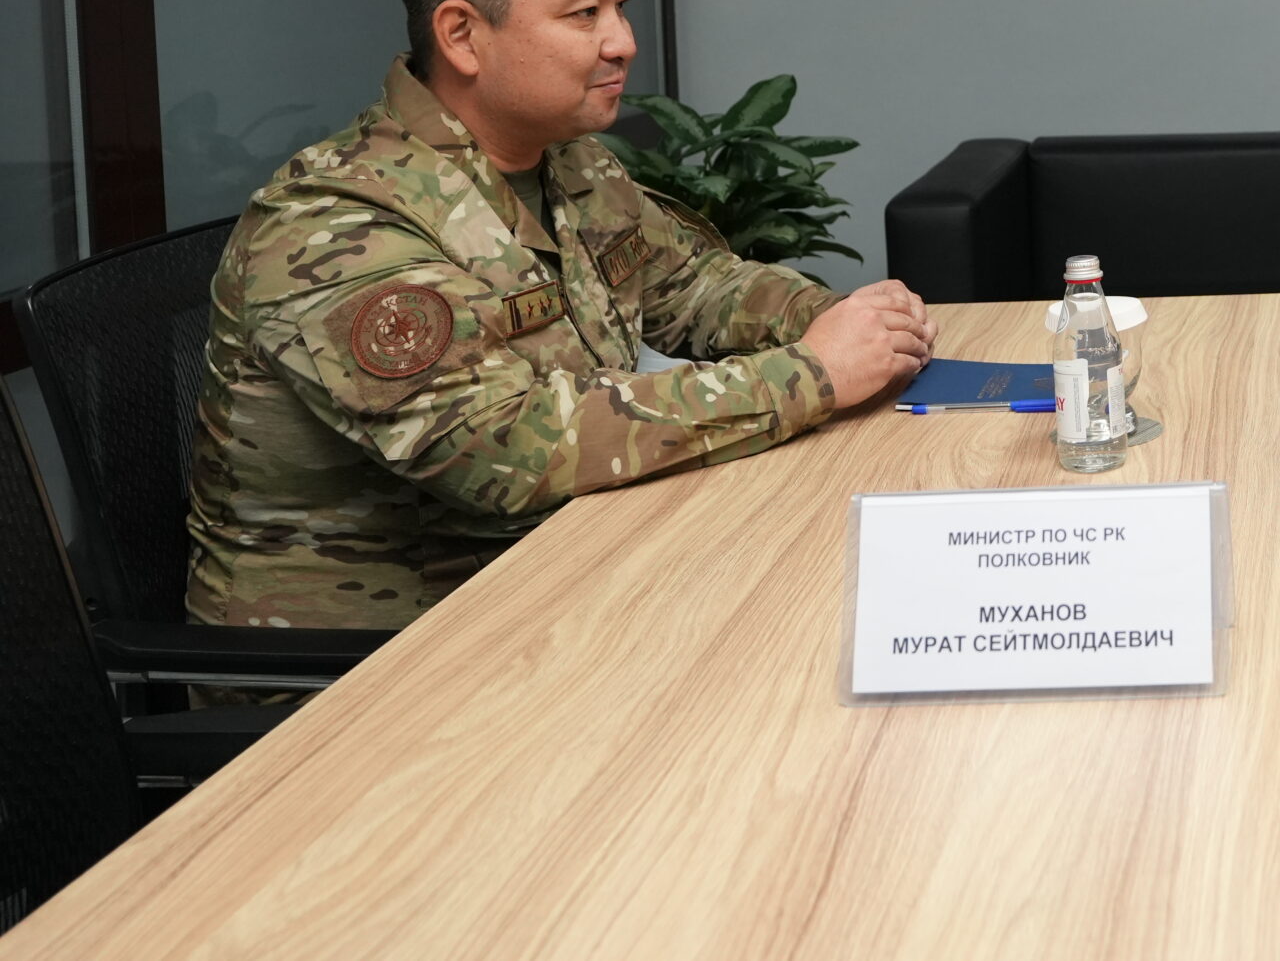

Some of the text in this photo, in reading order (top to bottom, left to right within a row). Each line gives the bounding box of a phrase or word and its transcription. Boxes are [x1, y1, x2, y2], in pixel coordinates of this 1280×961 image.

[948, 527, 1126, 546] МИНИСТР ПО ЧС РК
[977, 550, 1091, 568] ПОЛКОВНИК
[979, 603, 1088, 623] МУХАНОВ
[892, 628, 1174, 654] МУРАТ СЕЙТМОЛДАЕВИЧ
